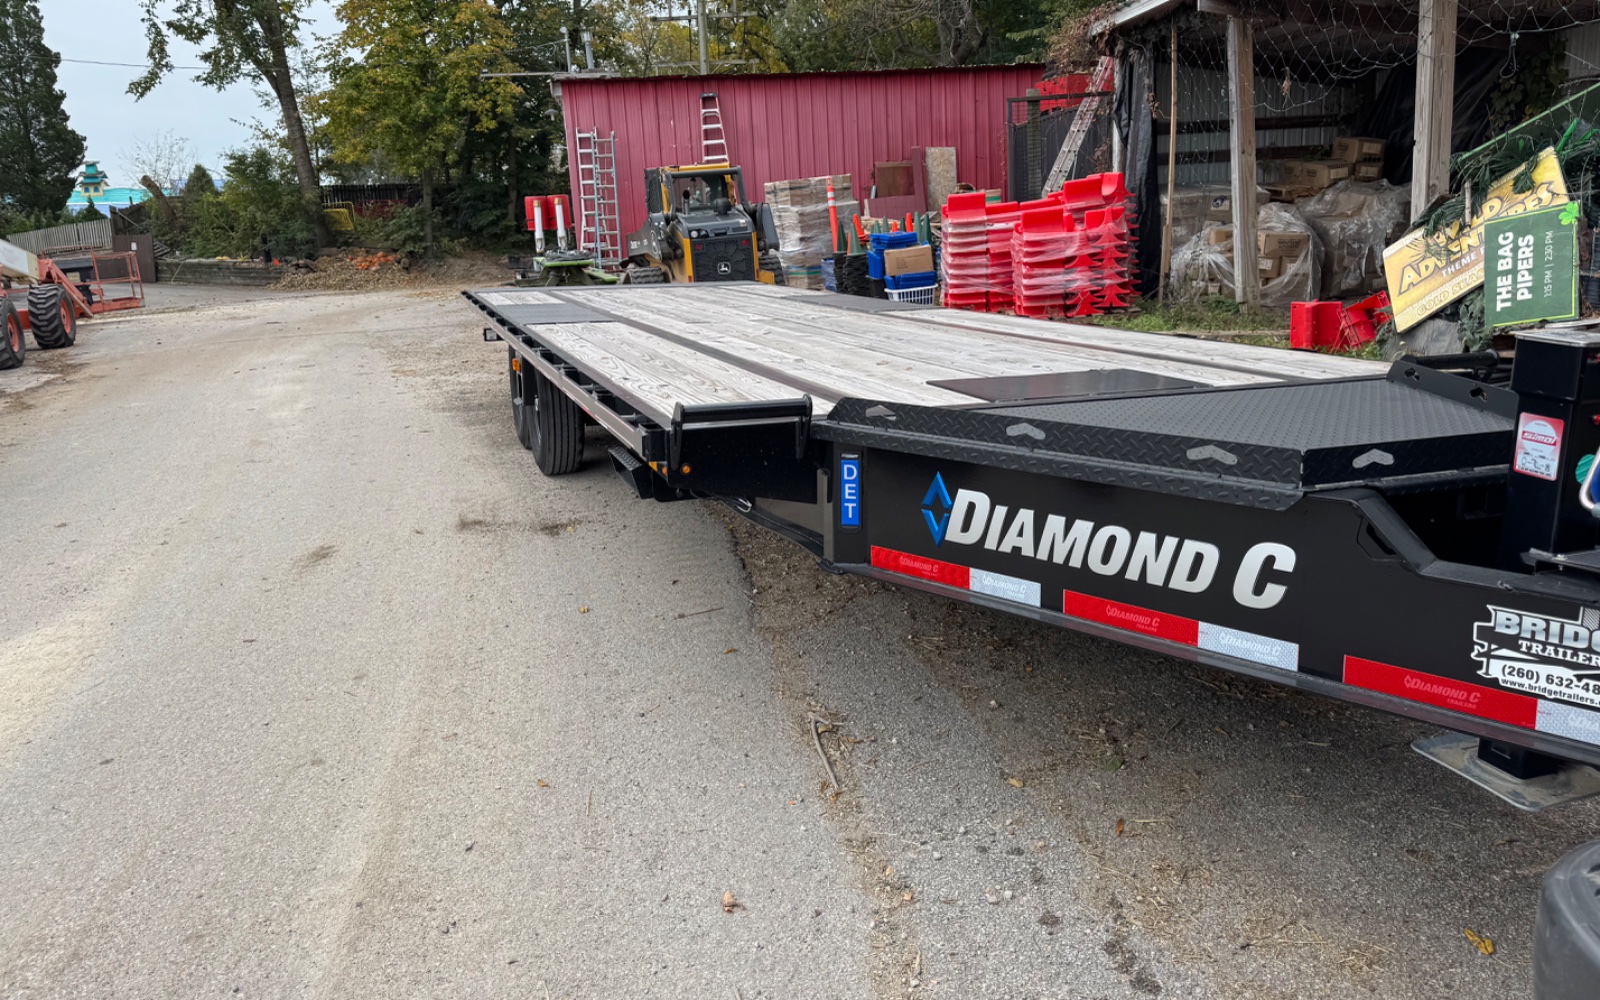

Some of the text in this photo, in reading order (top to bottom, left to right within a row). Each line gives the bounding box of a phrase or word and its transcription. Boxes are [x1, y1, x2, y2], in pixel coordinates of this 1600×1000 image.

[1545, 230, 1553, 244] PM
[1441, 253, 1478, 278] THEME
[1544, 244, 1553, 262] 2:30
[1496, 231, 1514, 312] THE BAG
[1517, 234, 1534, 301] PIPERS
[1544, 269, 1553, 283] PM
[1417, 289, 1450, 316] GOLD
[843, 464, 857, 519] DET
[945, 488, 1296, 609] DIAMOND C
[1110, 606, 1160, 628] DIAMOND C
[1501, 664, 1540, 684] (260)
[1410, 677, 1480, 703] DIAMOND C
[1501, 678, 1600, 706] www.bridgetrailers.
